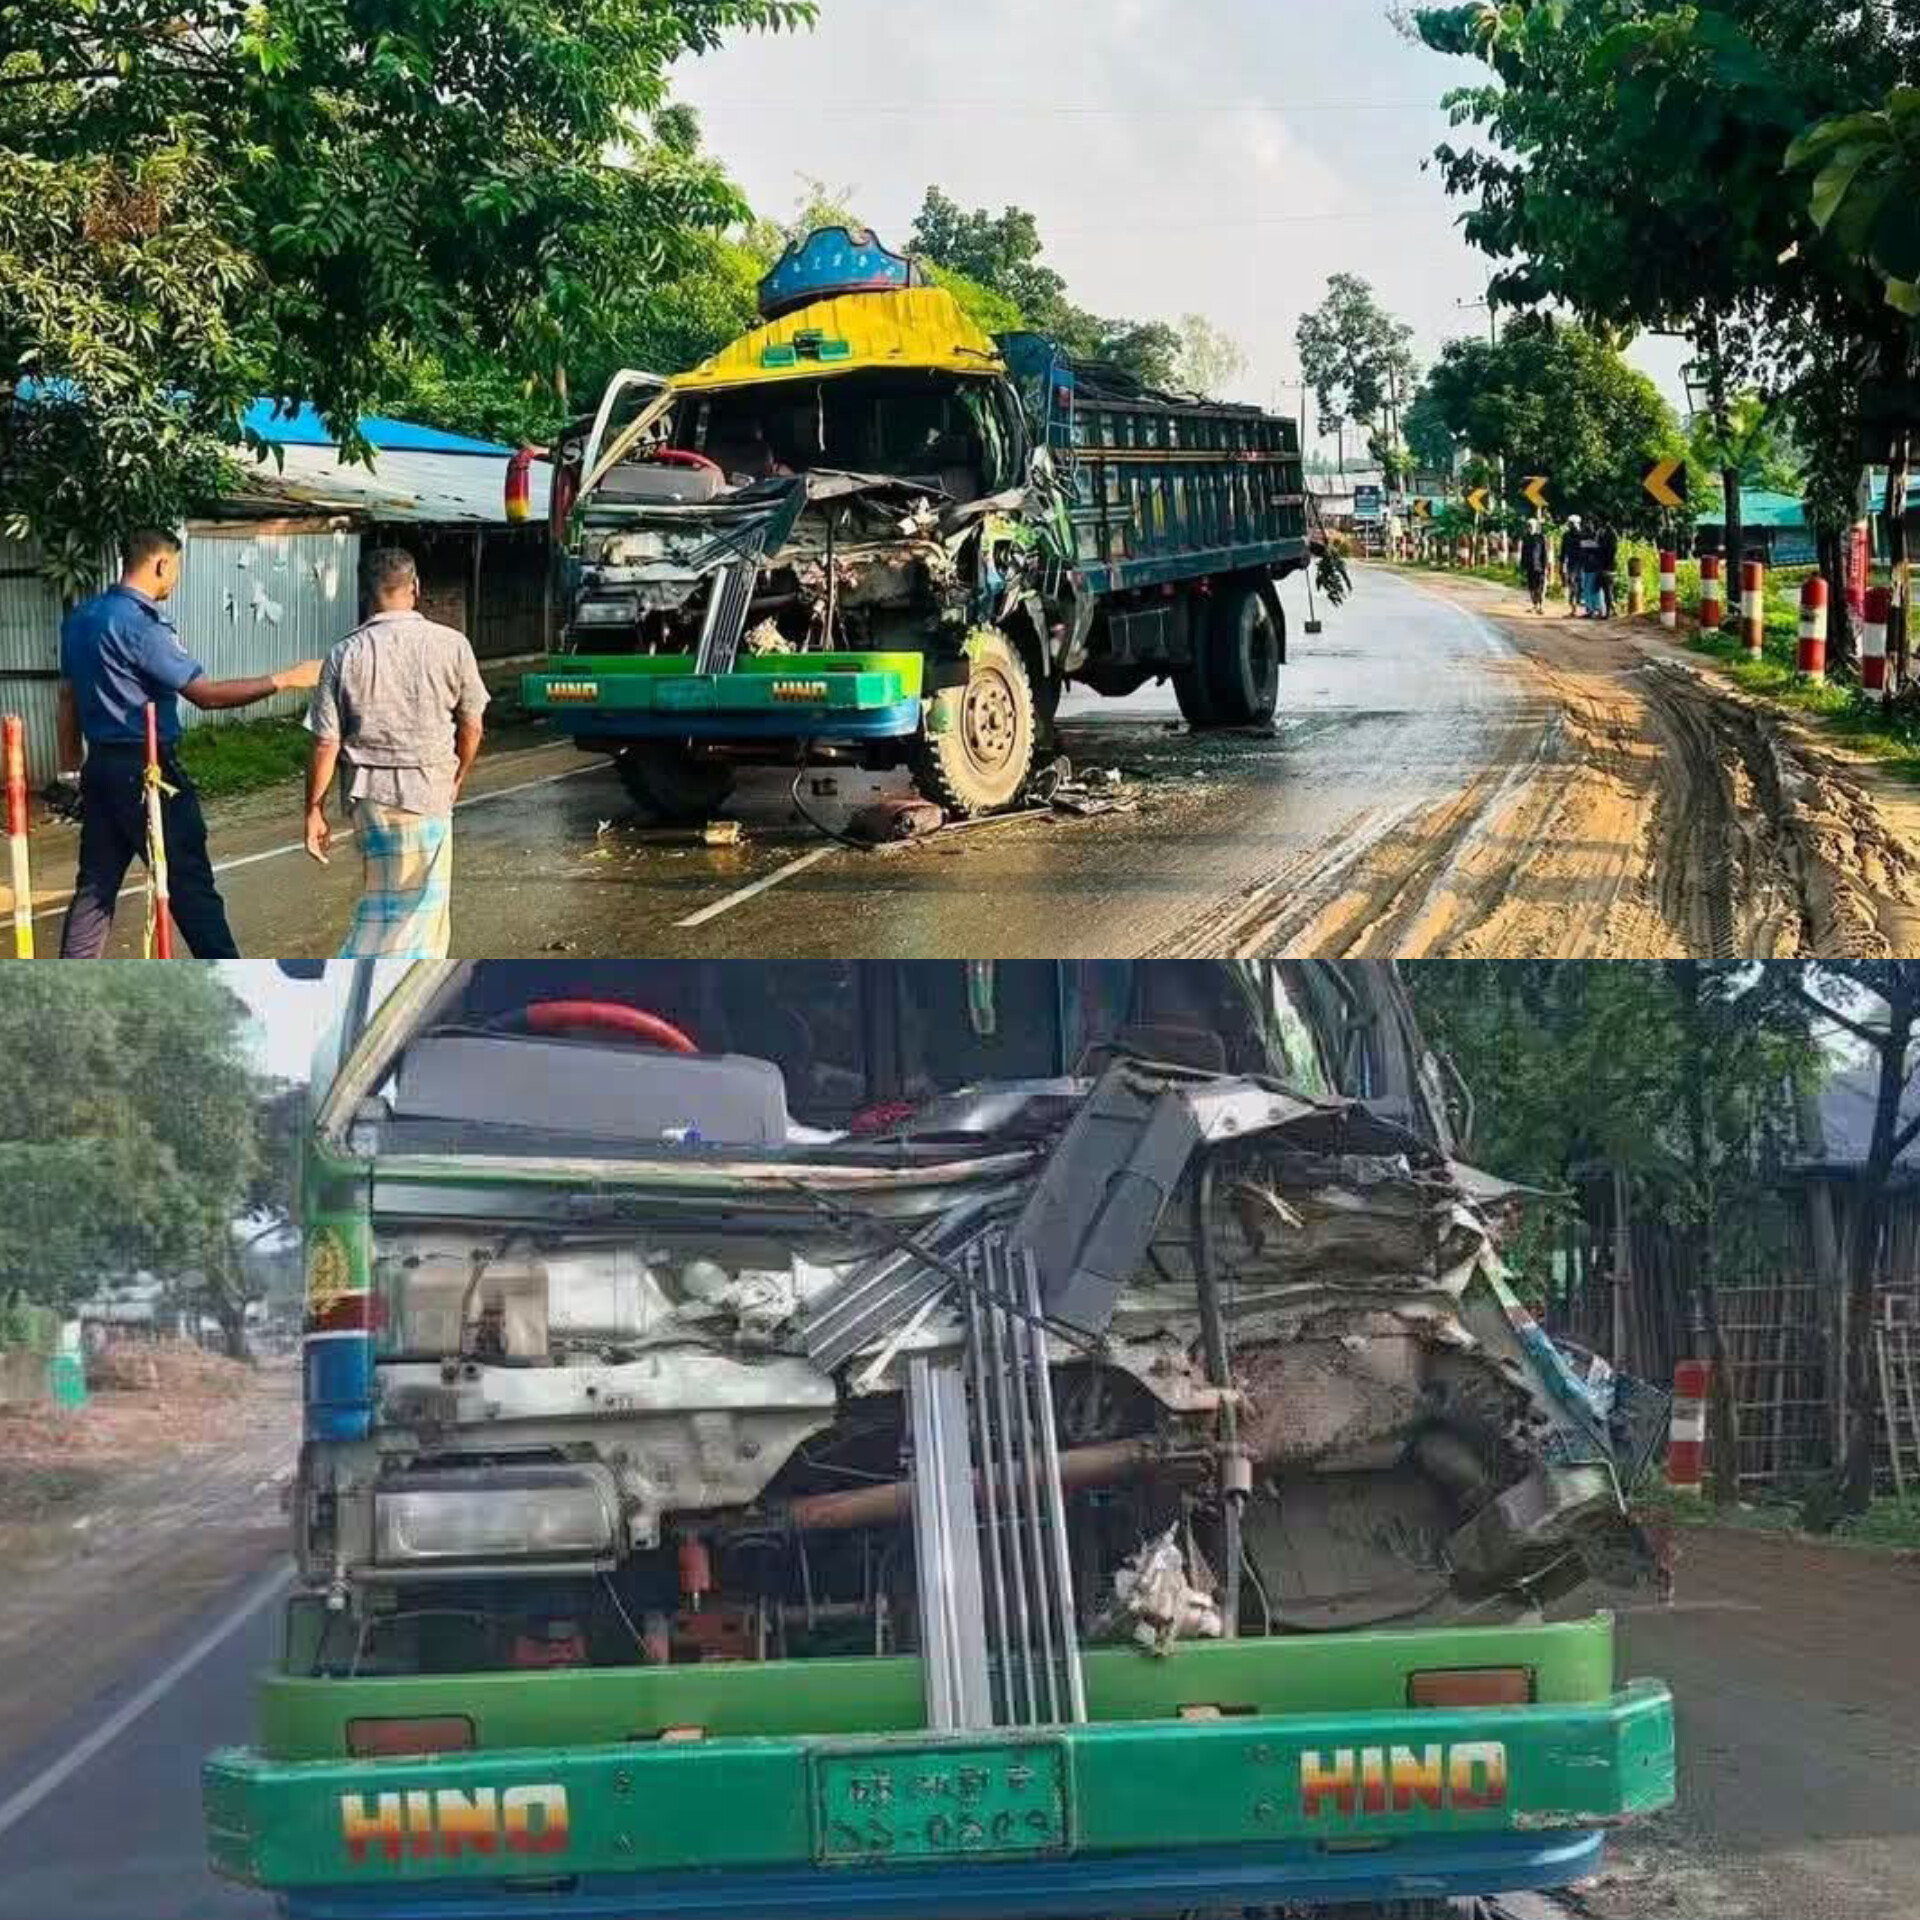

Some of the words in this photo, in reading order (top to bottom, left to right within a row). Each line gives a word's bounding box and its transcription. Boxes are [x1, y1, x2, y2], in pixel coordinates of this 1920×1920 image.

[546, 682, 598, 702] HINO
[772, 681, 827, 702] HINO
[1301, 1741, 1508, 1817] HINO
[341, 1784, 569, 1861] HINO
